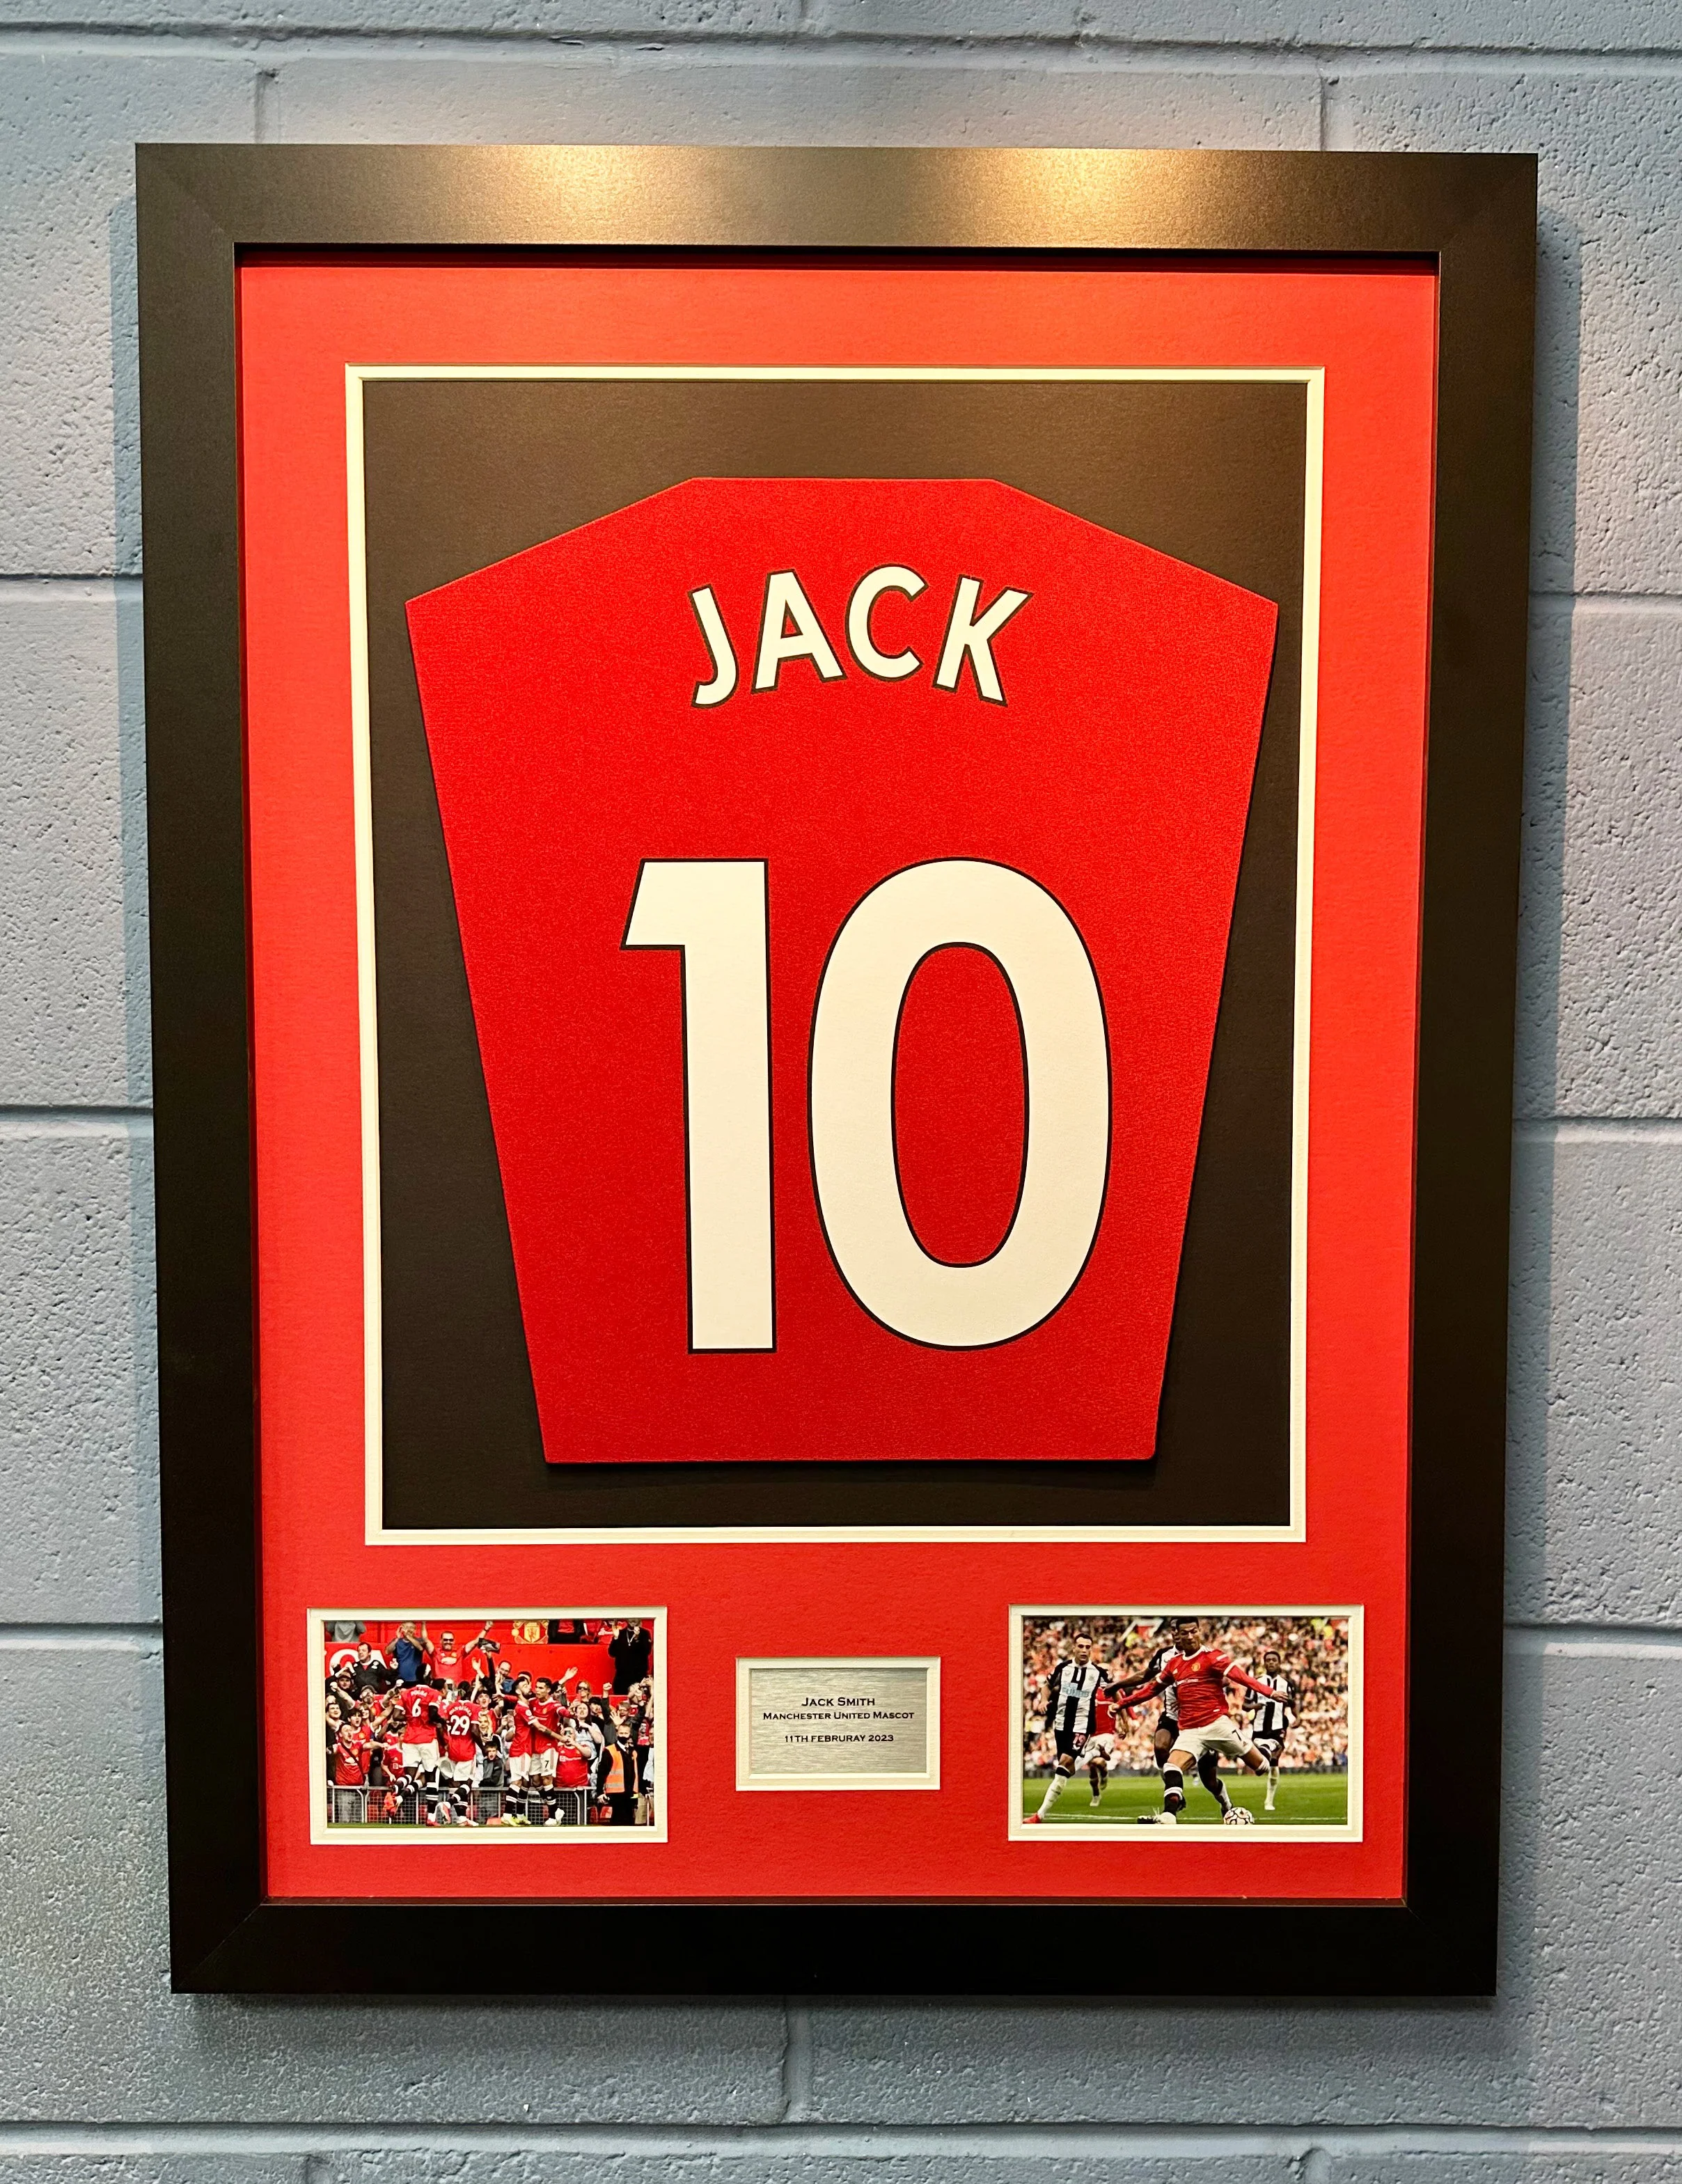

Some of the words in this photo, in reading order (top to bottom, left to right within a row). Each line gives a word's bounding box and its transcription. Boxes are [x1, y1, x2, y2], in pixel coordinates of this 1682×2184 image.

[687, 563, 1035, 708] JACK
[620, 856, 1113, 1353] 10
[411, 1698, 421, 1718] 6
[801, 1697, 835, 1706] JACK
[837, 1697, 875, 1706] SMITH
[763, 1712, 831, 1720] MANCHESTER
[833, 1711, 870, 1720] UNITED
[873, 1711, 915, 1720] MASCOT
[450, 1715, 470, 1736] 29
[785, 1734, 809, 1743] 11TH
[811, 1734, 867, 1743] FEBRURAY
[544, 1760, 549, 1768] 7
